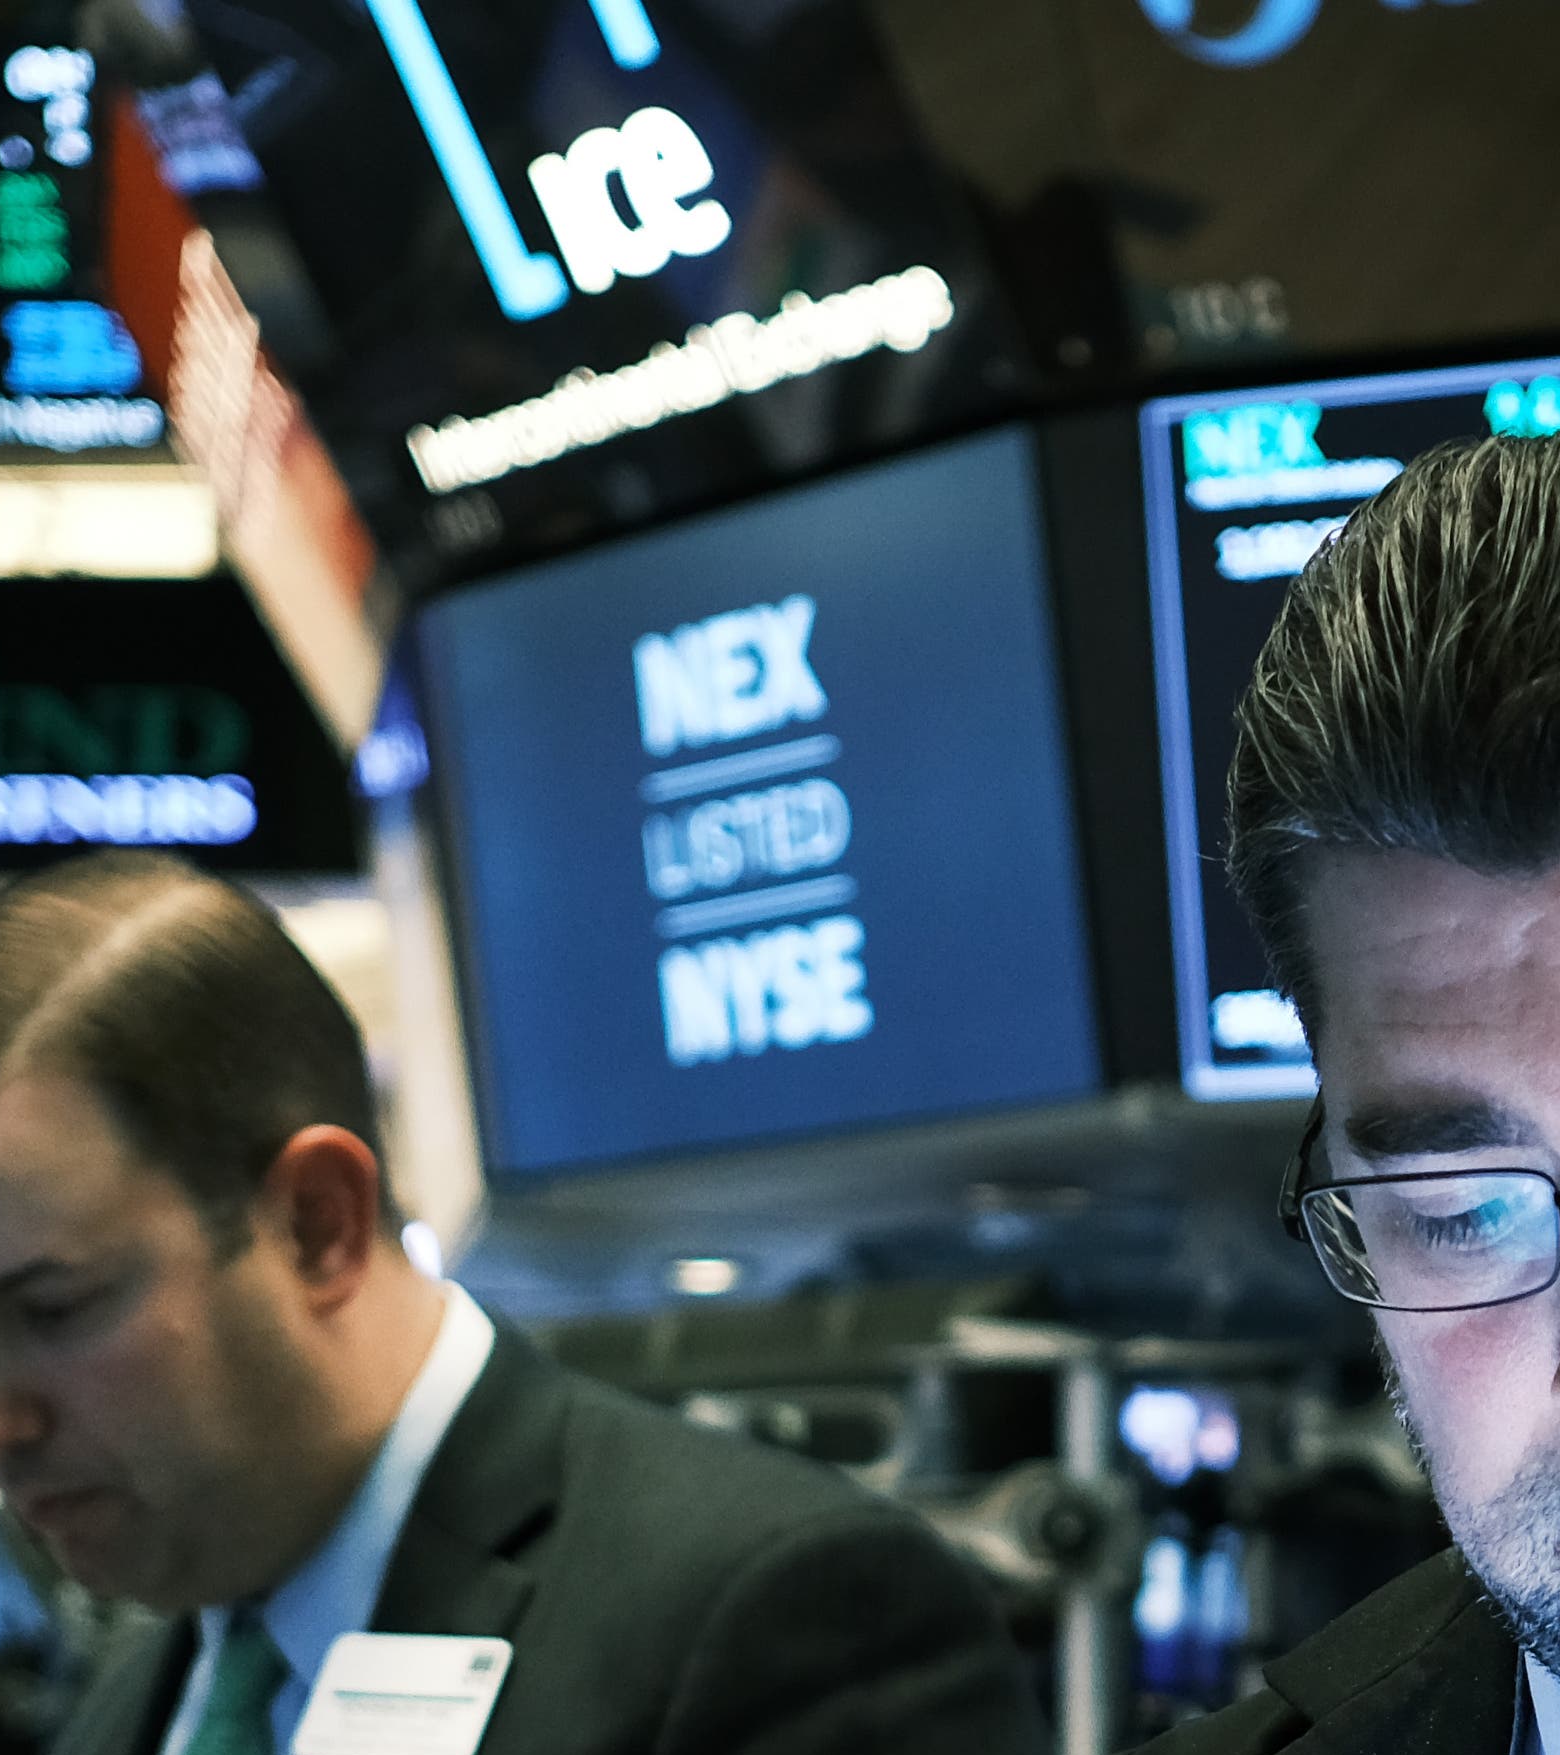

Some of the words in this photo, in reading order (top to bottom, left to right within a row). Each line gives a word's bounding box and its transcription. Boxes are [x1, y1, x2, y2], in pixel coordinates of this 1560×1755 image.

[633, 594, 831, 758] NEX
[642, 777, 852, 899] LISTED
[658, 914, 876, 1067] NYSE
